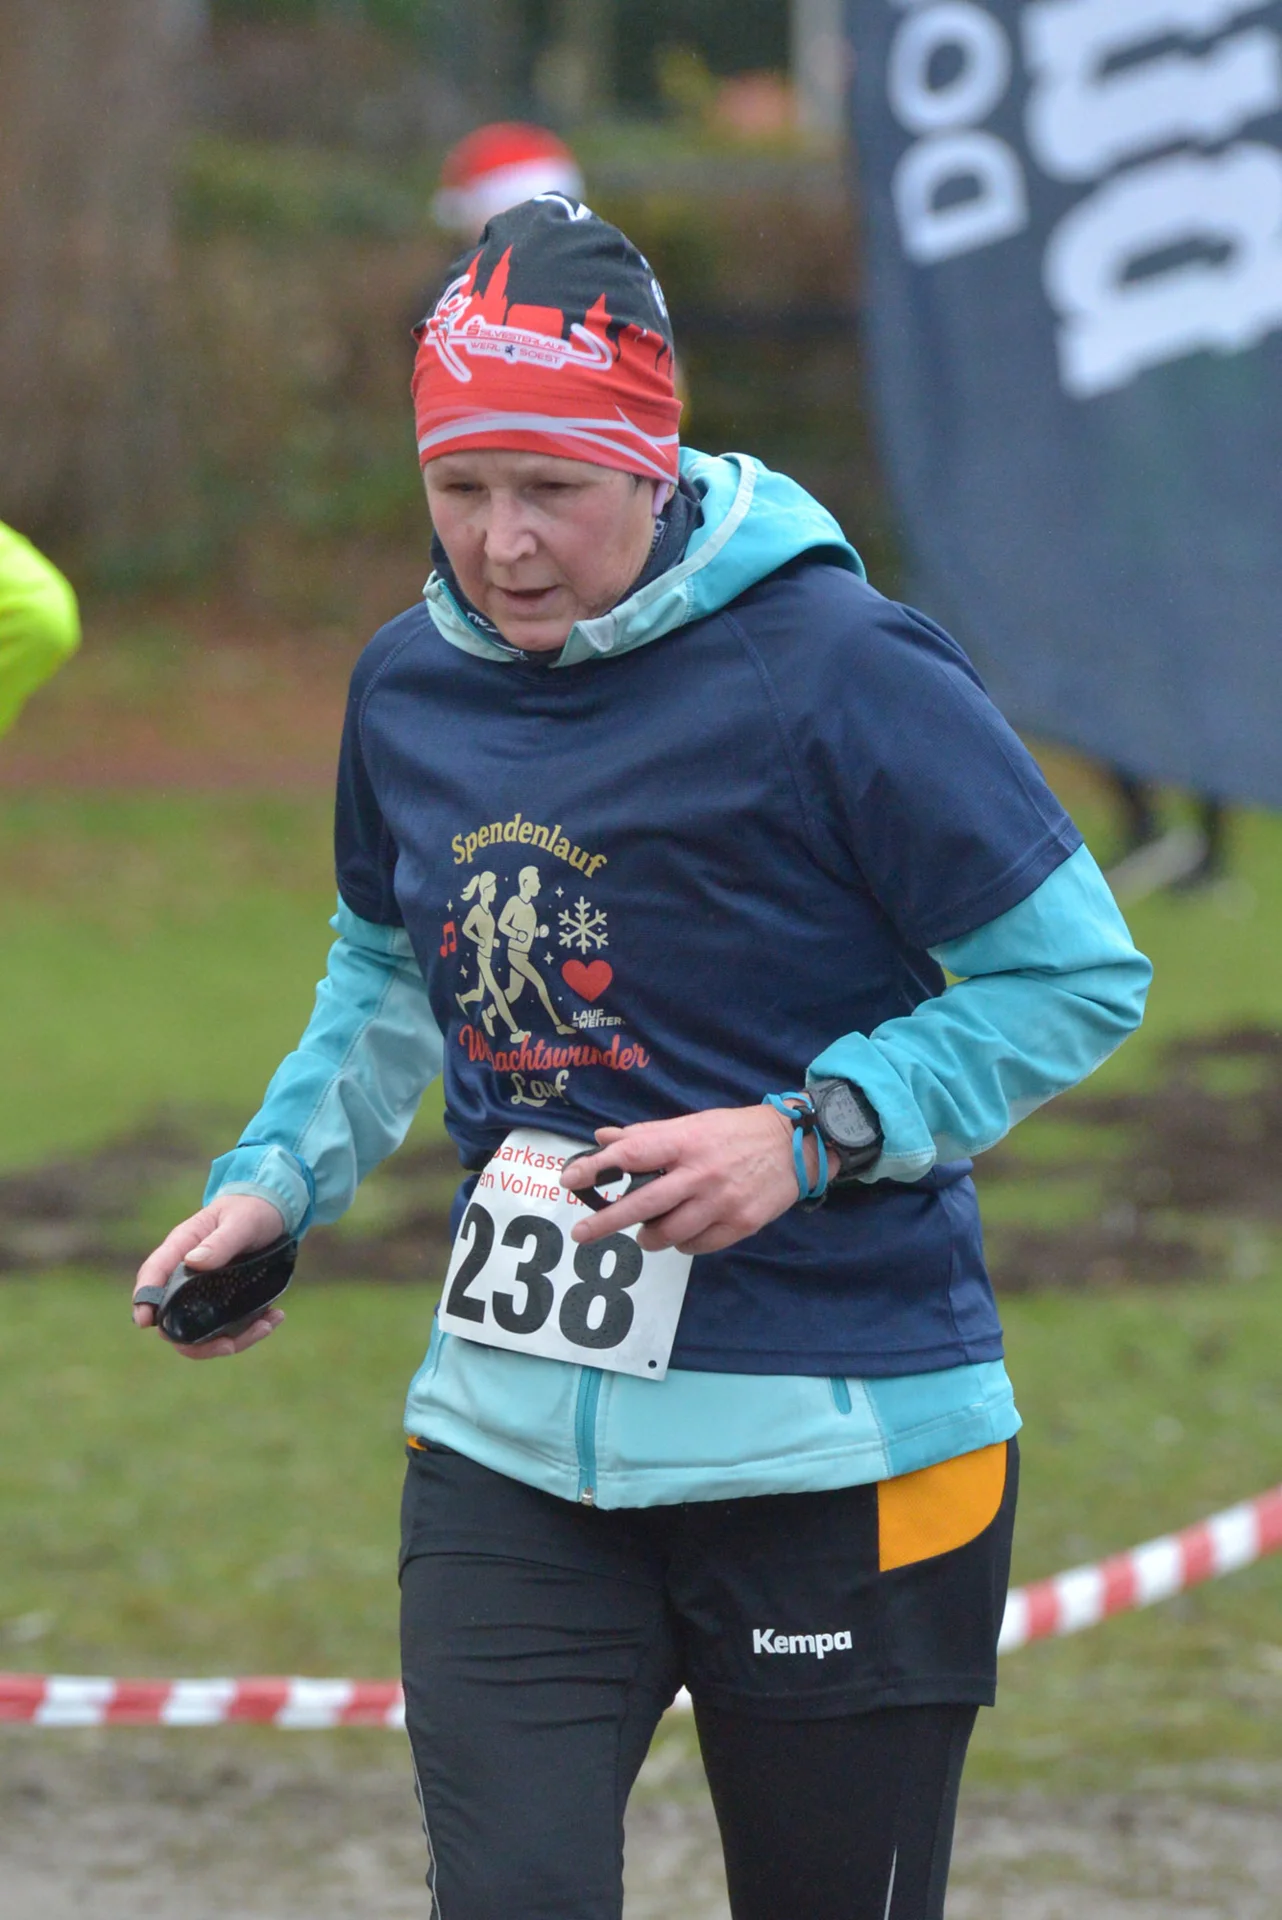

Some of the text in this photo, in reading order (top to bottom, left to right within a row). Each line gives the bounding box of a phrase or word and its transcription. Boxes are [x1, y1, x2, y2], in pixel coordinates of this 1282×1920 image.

[470, 340, 560, 364] WERL SOEST
[451, 812, 608, 878] Spendenlauf
[572, 1008, 605, 1021] LAUF
[510, 1069, 571, 1108] Lauf
[500, 1171, 560, 1202] Volme
[445, 1201, 644, 1350] 238
[752, 1628, 853, 1660] Kempa
